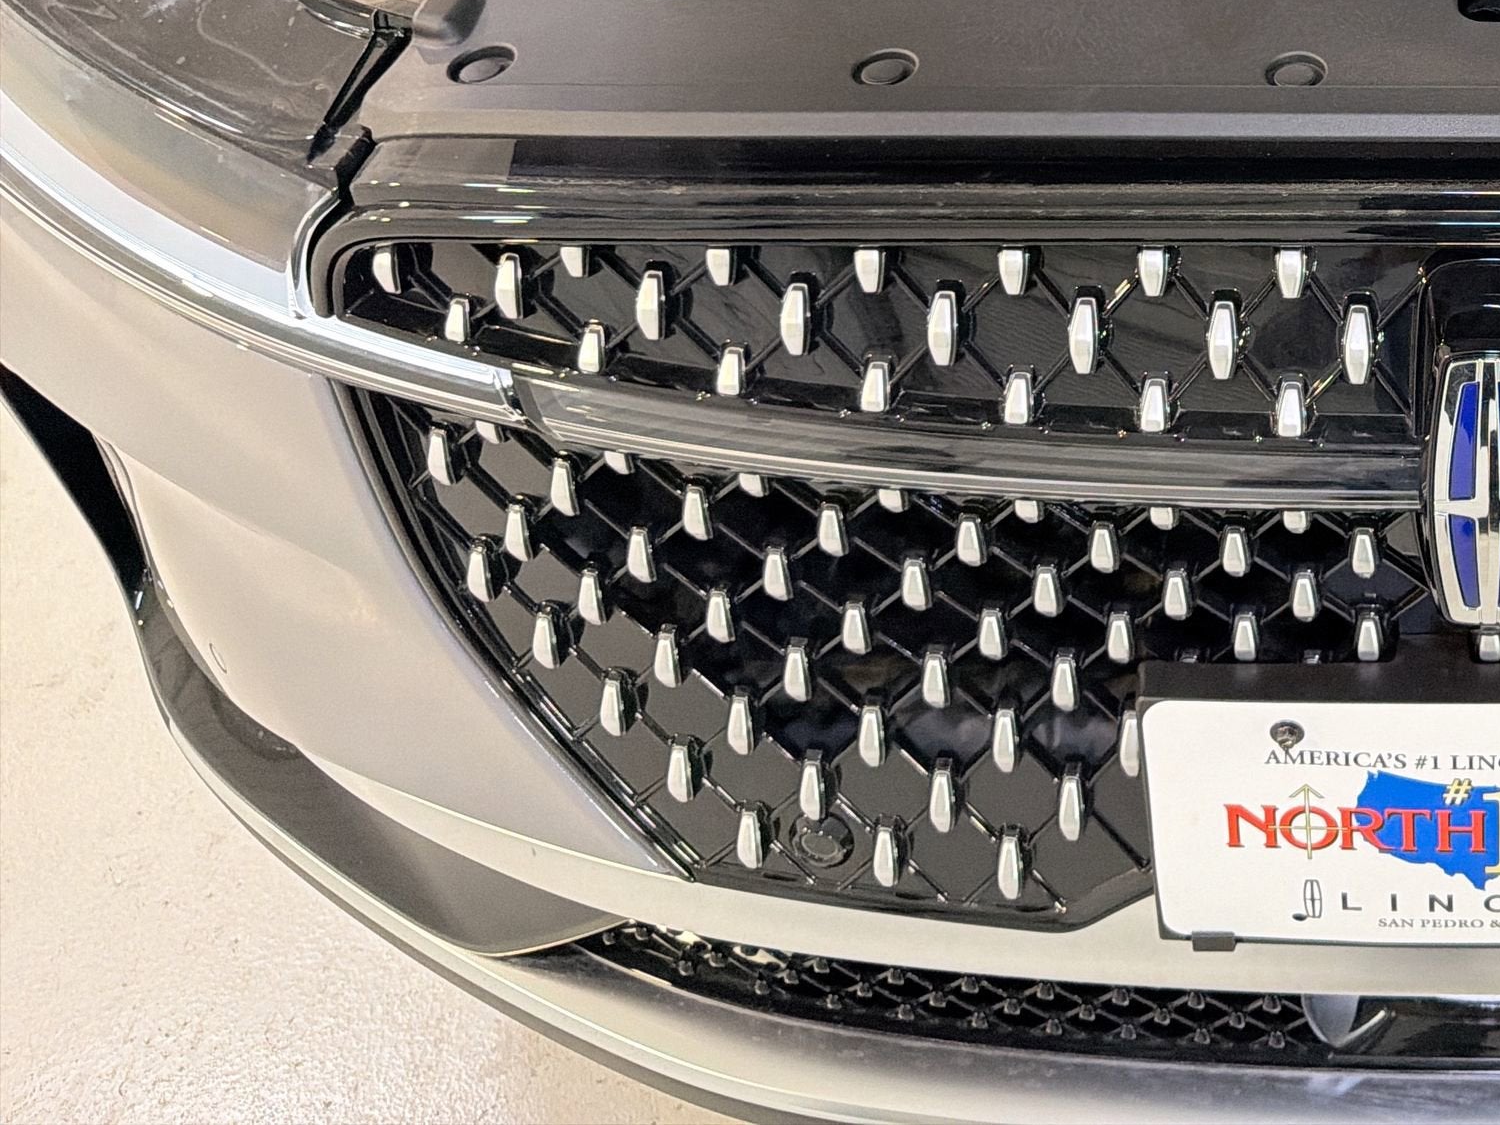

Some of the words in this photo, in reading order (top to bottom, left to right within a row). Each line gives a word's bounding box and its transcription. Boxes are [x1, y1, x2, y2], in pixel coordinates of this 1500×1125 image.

[1264, 749, 1407, 769] AMERICA'S
[1415, 754, 1441, 770] #1
[1223, 804, 1487, 853] NORTH
[1378, 918, 1414, 928] SAN
[1421, 918, 1485, 929] PEDRO
